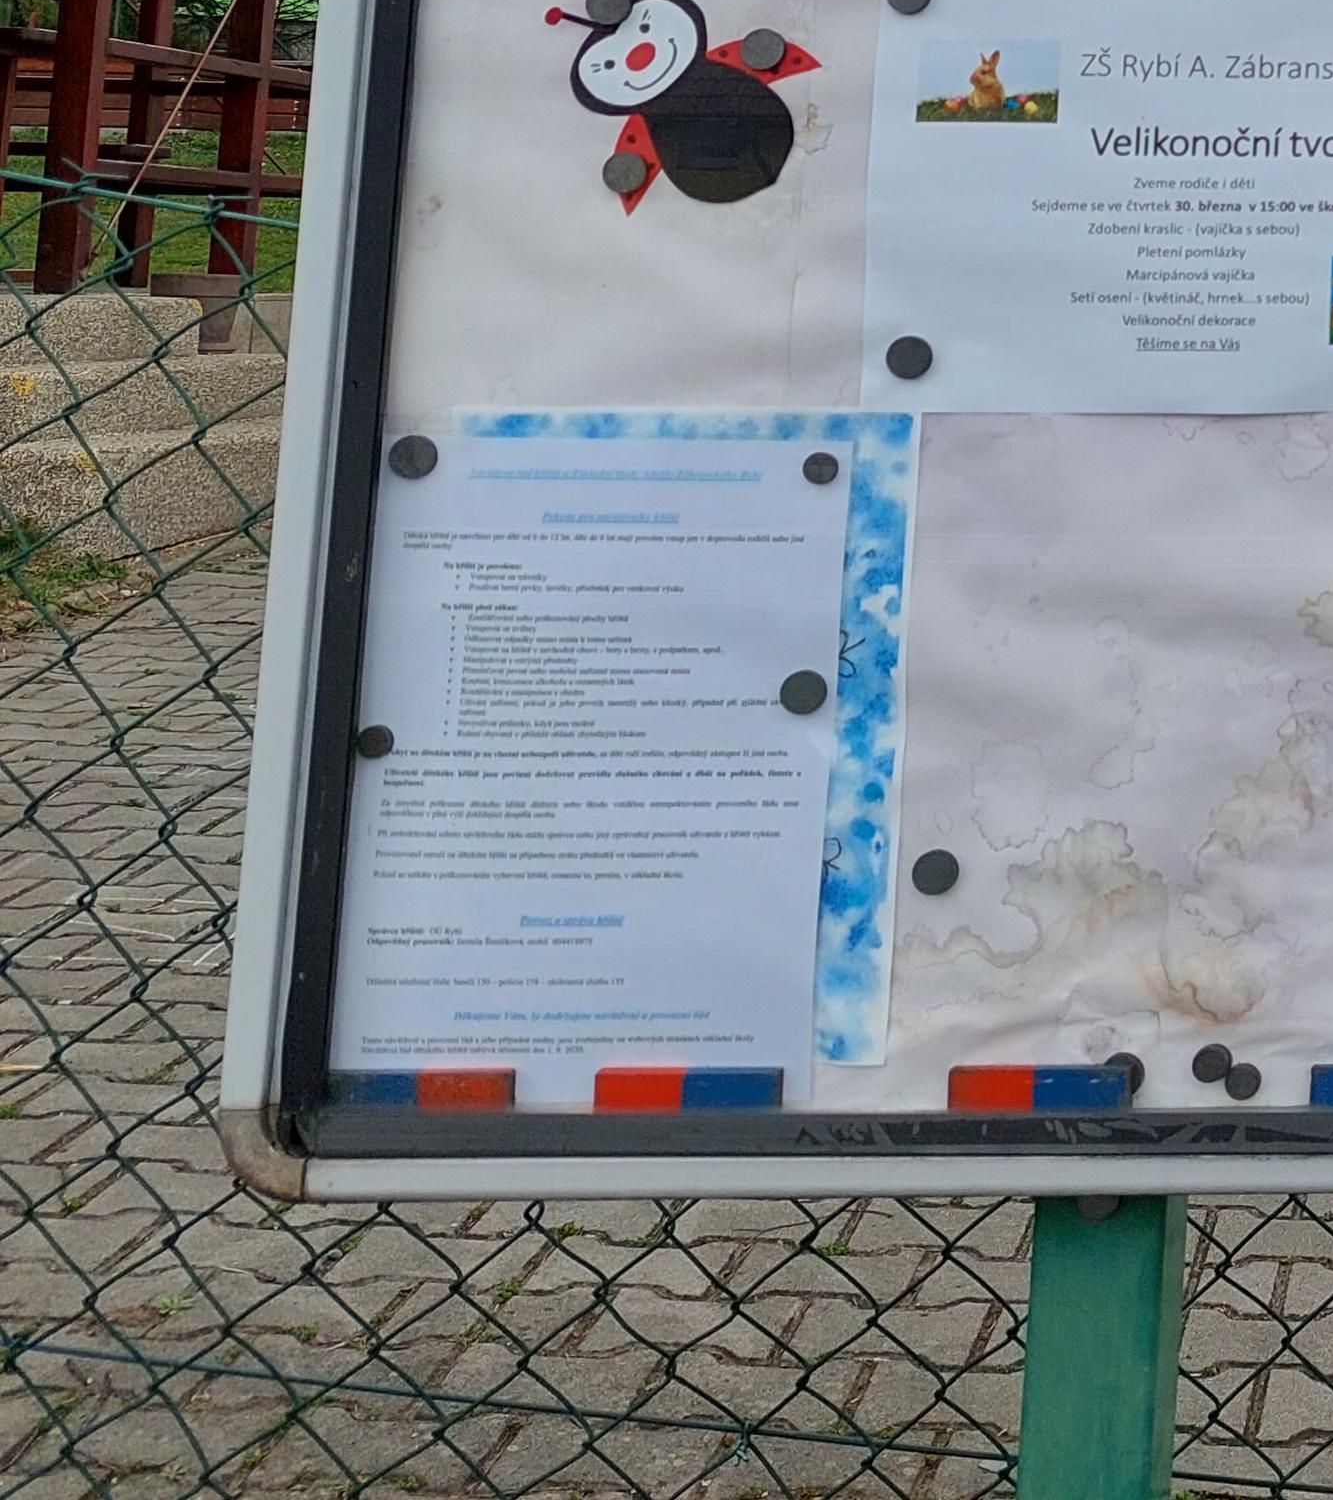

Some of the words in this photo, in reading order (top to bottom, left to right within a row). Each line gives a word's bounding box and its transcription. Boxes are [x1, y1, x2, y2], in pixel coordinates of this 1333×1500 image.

[1080, 47, 1111, 76] ZŠ
[1122, 52, 1179, 83] Rybí
[1188, 55, 1214, 77] A.
[1091, 126, 1280, 156] Velikonoční
[1133, 177, 1176, 189] Zveme
[1179, 177, 1219, 189] rodiče
[1222, 178, 1226, 188] i
[1032, 199, 1087, 214] Sejdeme
[1090, 202, 1104, 211] se
[1107, 202, 1122, 211] ve
[1126, 199, 1170, 211] čtvrtek
[1174, 200, 1193, 211] 30.
[1197, 200, 1242, 211] března
[1248, 203, 1256, 212] v
[1260, 200, 1296, 212] 15:00
[1298, 203, 1314, 212] ve
[1087, 222, 1140, 234] Zdobení
[1143, 223, 1183, 234] kraslic
[1194, 223, 1243, 237] (vajíčka
[1246, 225, 1252, 235] s
[1255, 223, 1300, 237] sebou)
[1136, 245, 1182, 257] Pletení
[1184, 245, 1246, 260] pomlázky
[1125, 269, 1209, 283] Marcipánová
[1212, 269, 1255, 283] vajíčka
[1097, 291, 1132, 303] osení
[1142, 291, 1204, 305] (květináč,
[1265, 292, 1309, 305] sebou)
[1122, 314, 1195, 326] Velikonoční
[1197, 314, 1256, 326] dekorace
[1182, 340, 1197, 351] se
[1200, 340, 1216, 351] na
[1218, 337, 1240, 351] Vás
